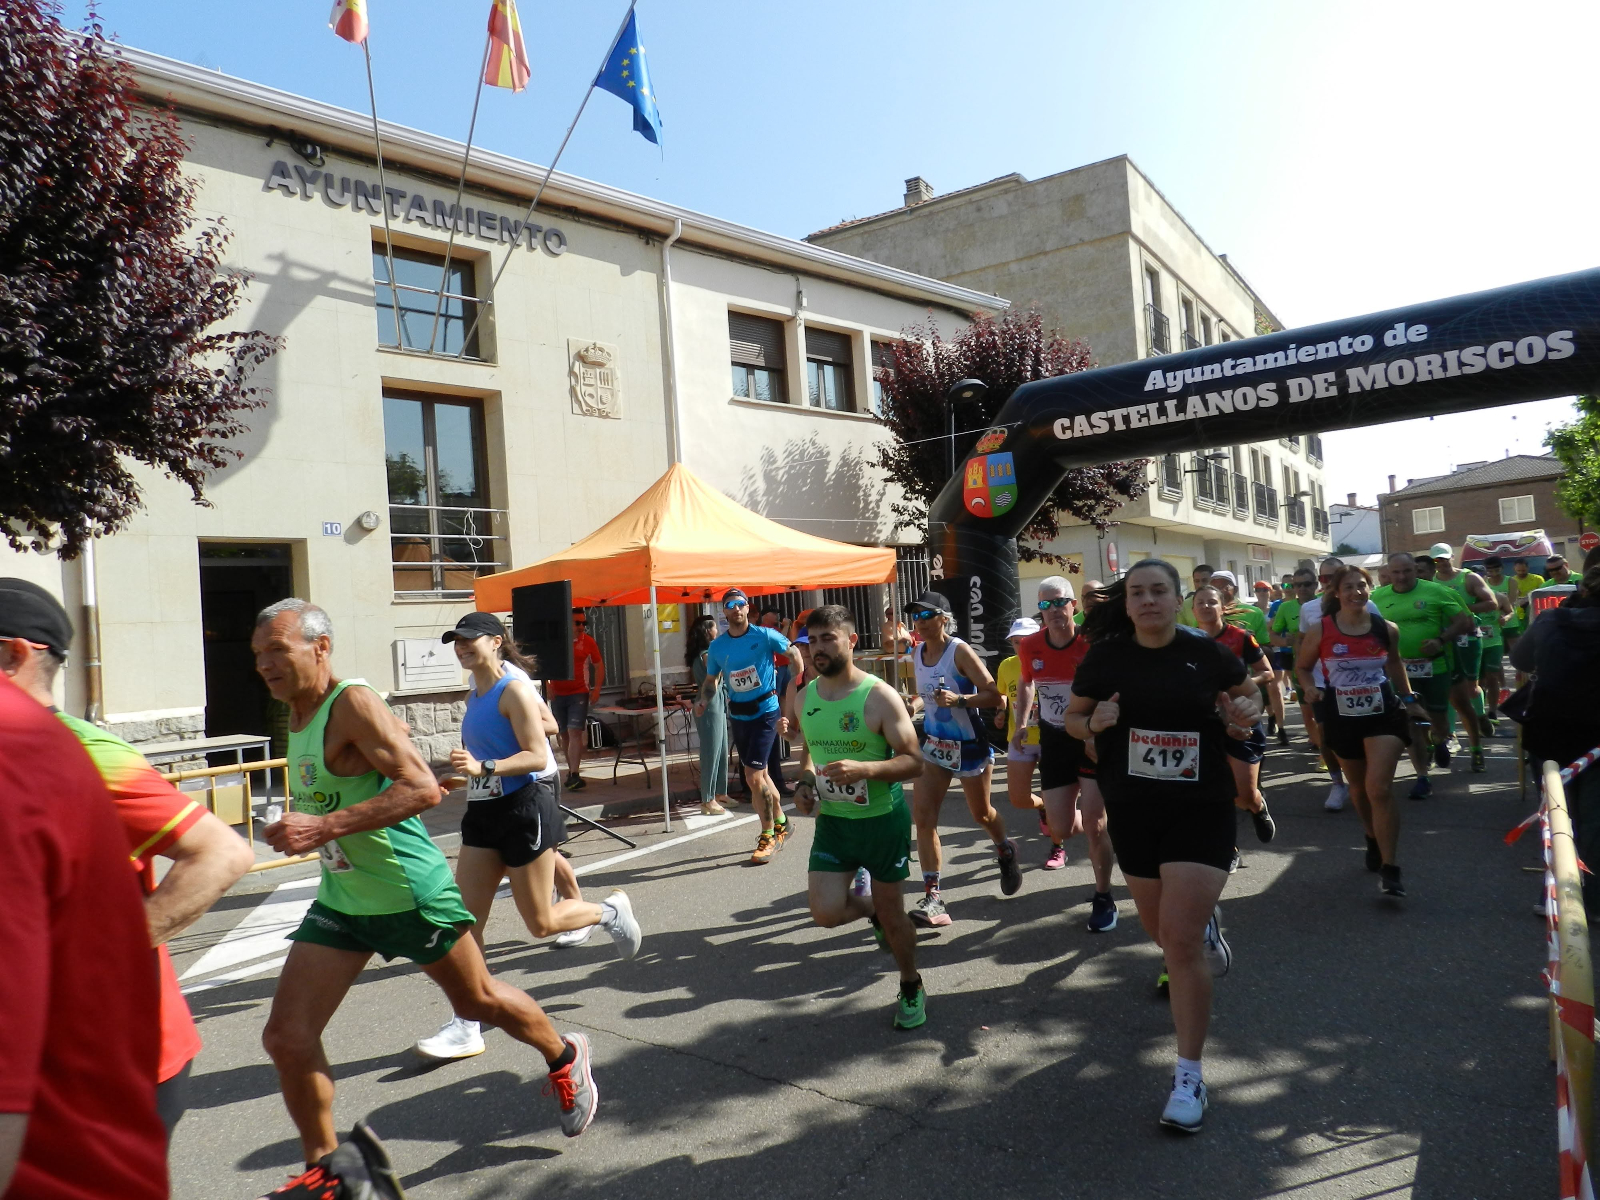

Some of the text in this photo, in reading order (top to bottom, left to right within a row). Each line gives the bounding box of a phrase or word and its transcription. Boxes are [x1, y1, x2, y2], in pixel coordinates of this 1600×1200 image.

[268, 160, 568, 256] AYUNTAMIENTO
[1144, 322, 1428, 393] Ayuntamiento de
[1053, 330, 1575, 440] CASTELLANOS DE MORISCOS
[324, 523, 341, 535] 10
[1406, 664, 1426, 673] 439
[734, 675, 753, 687] 391
[1336, 686, 1380, 697] bedunia
[1345, 695, 1374, 709] 349
[1130, 731, 1198, 747] bedunia
[823, 746, 856, 754] TELECOM
[929, 747, 953, 761] 436
[1142, 747, 1185, 768] 419
[470, 776, 491, 790] 392
